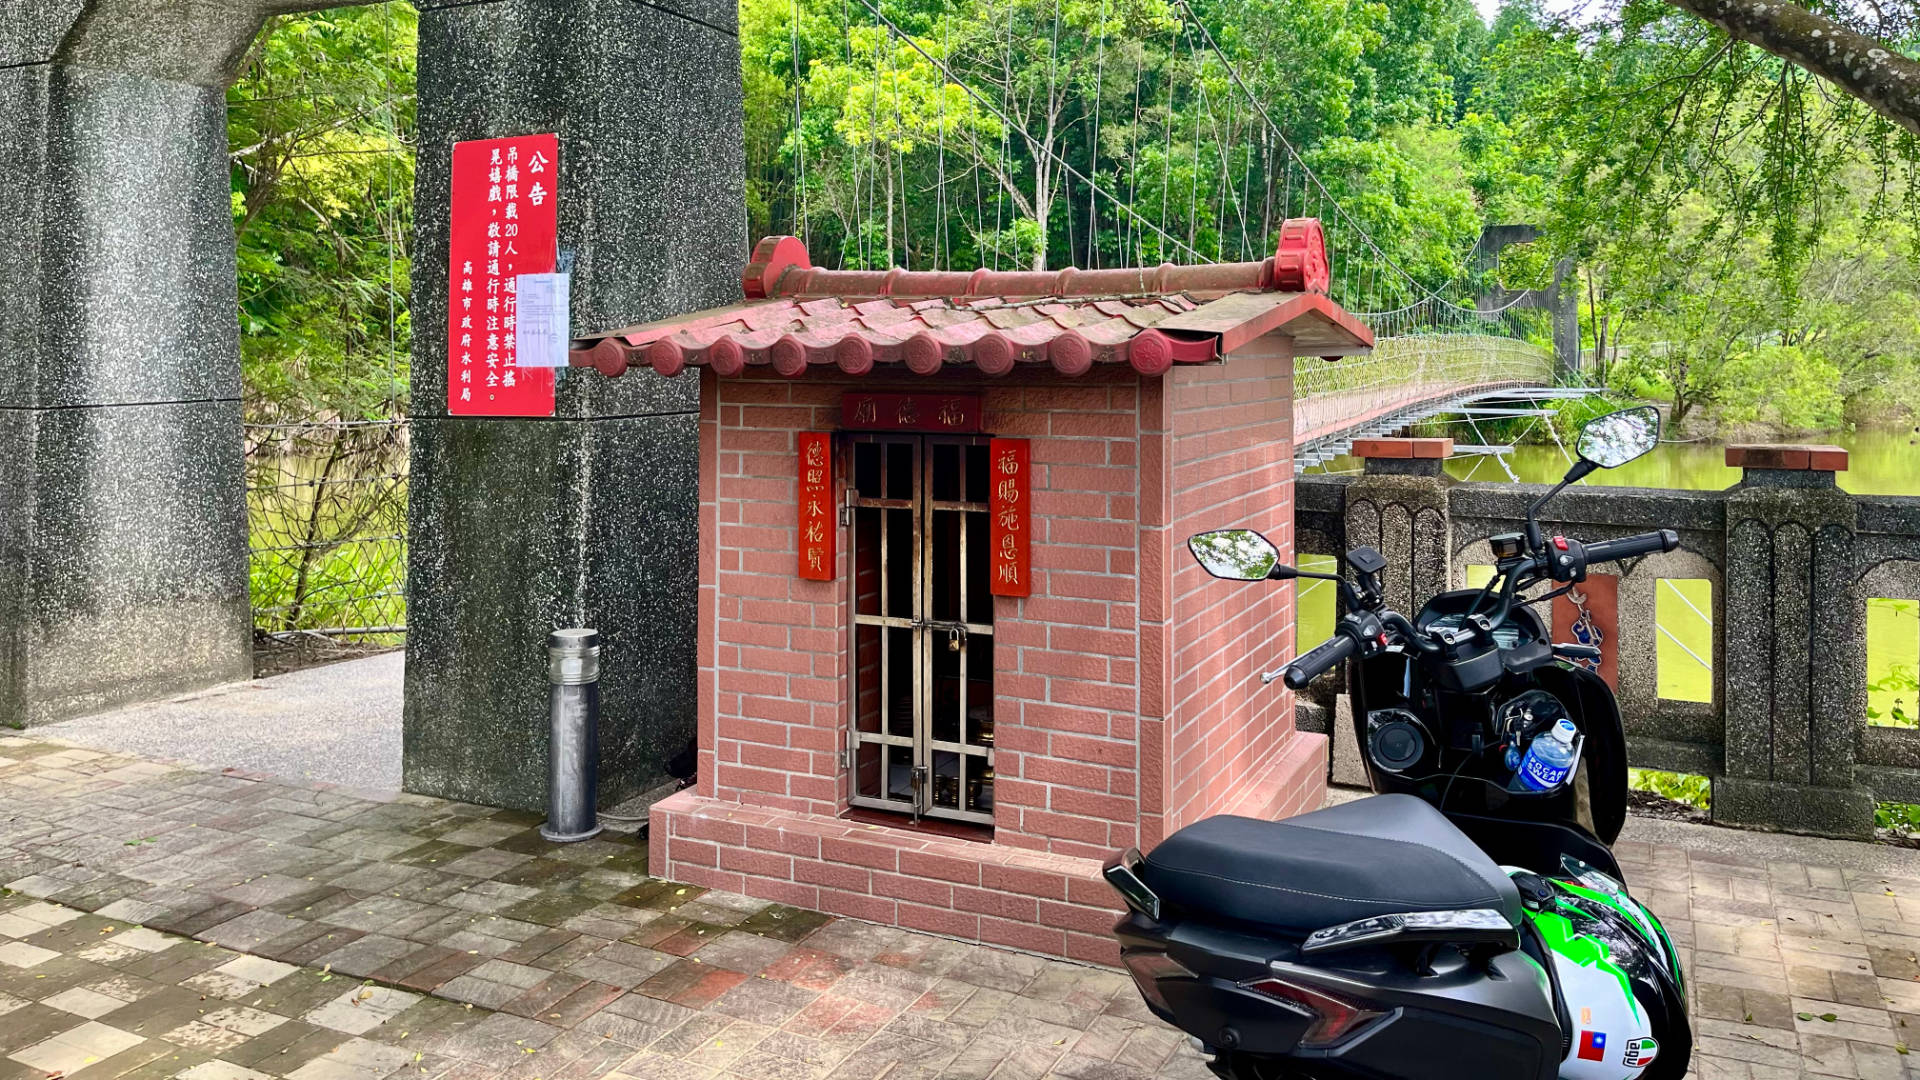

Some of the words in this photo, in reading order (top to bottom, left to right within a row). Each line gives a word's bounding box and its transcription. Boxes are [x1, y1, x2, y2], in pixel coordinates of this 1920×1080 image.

[528, 150, 550, 207] 公告
[460, 261, 473, 402] 高雄市政府水利局
[1528, 763, 1562, 782] SWEAT
